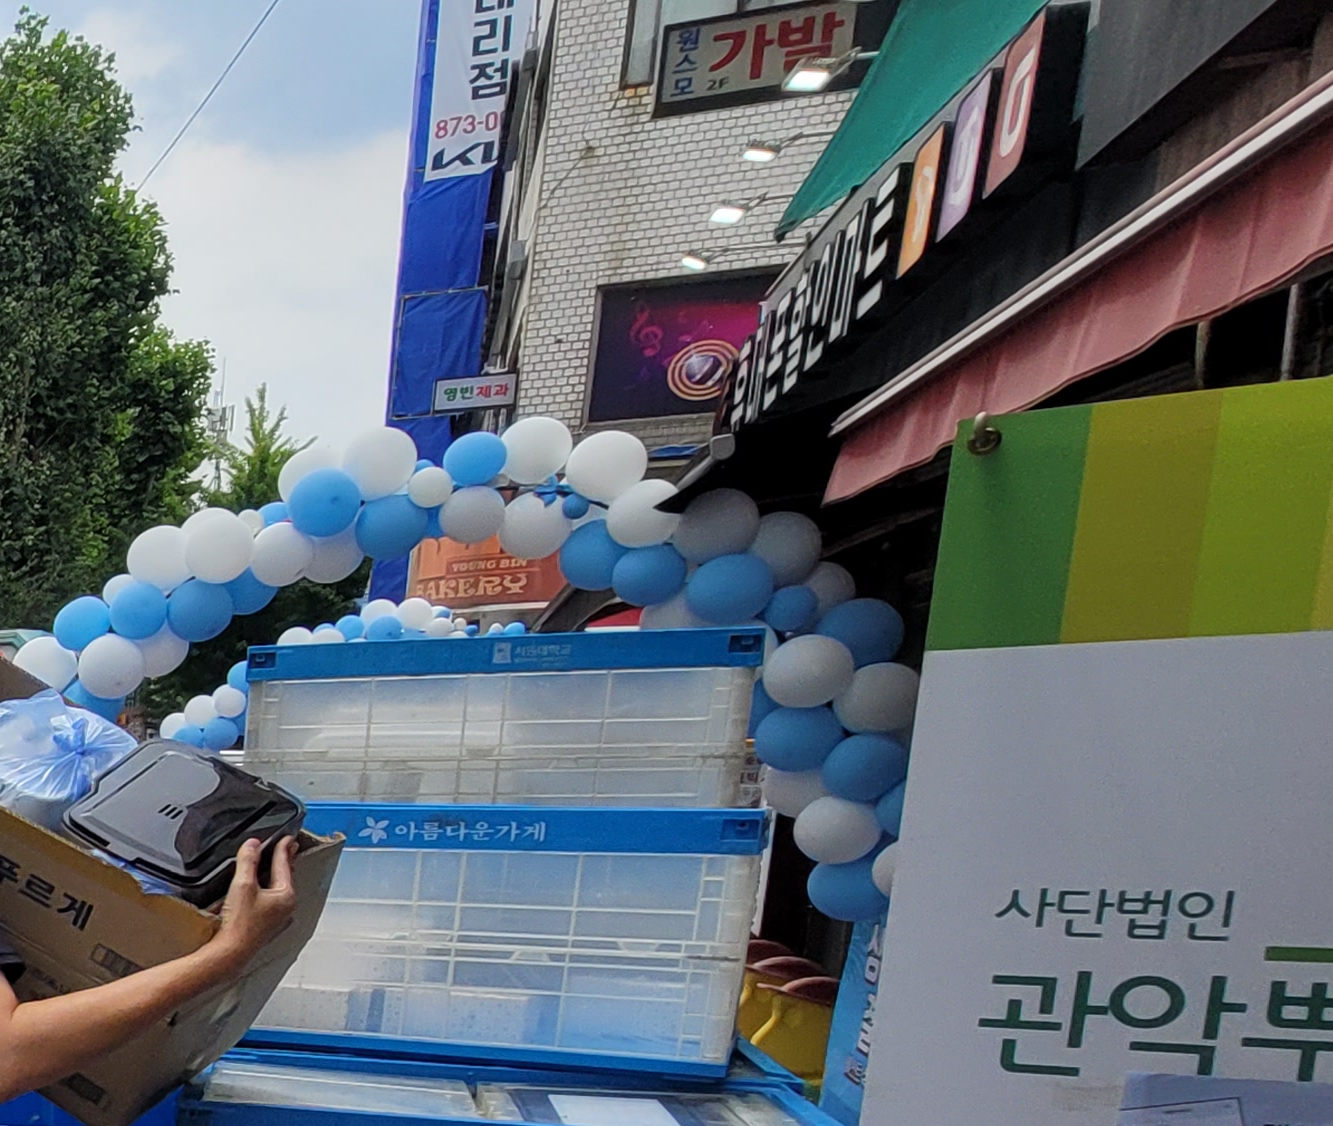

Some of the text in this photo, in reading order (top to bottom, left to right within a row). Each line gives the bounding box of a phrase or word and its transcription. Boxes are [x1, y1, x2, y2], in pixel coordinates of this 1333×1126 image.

[709, 10, 844, 80] 가발
[669, 27, 700, 97] 원스모
[706, 76, 730, 92] 2F
[443, 382, 510, 401] 영빈제과
[452, 559, 497, 573] YOUNG
[394, 821, 547, 844] 아름다운가게
[994, 887, 1236, 942] 사단법인
